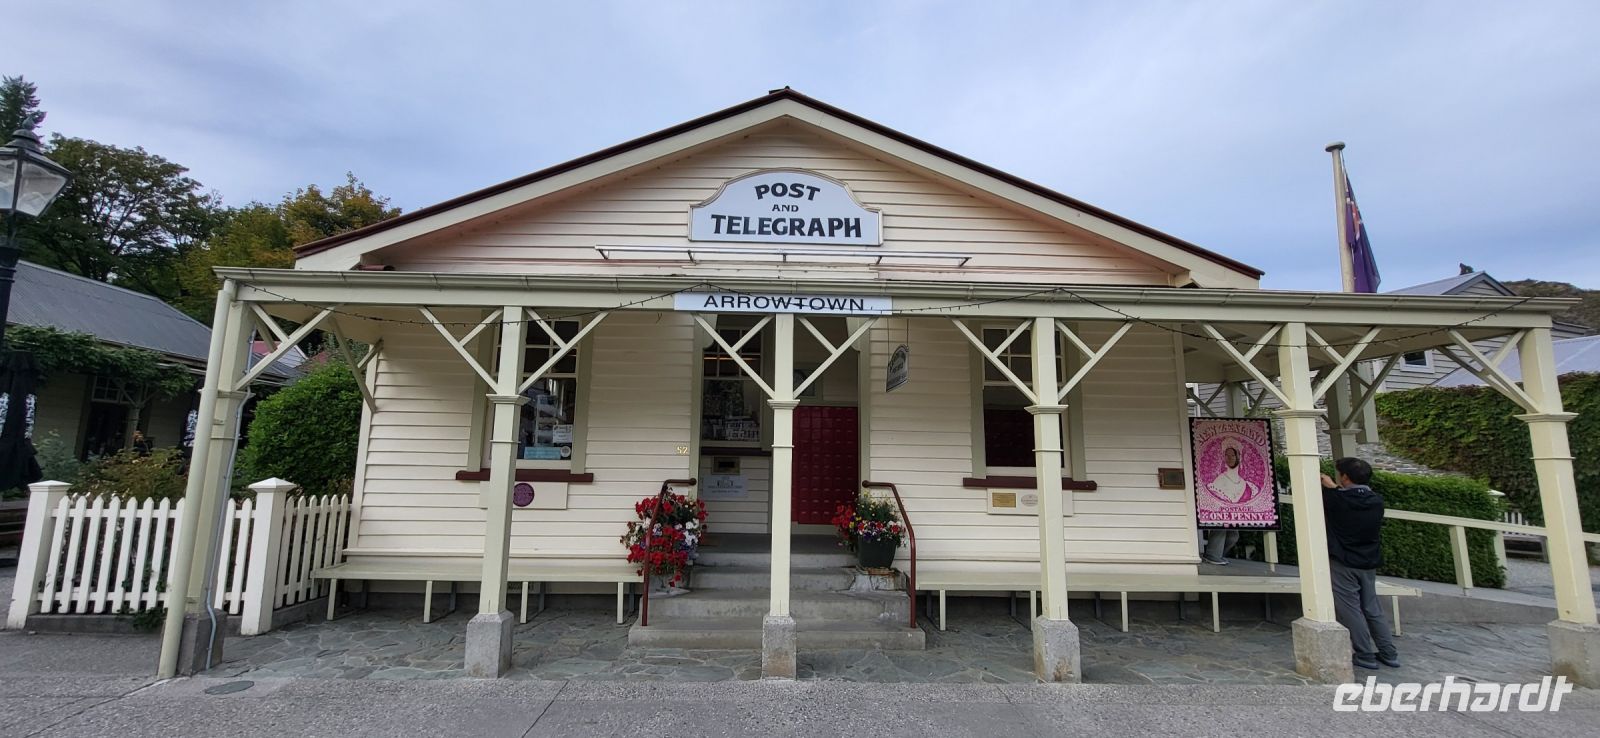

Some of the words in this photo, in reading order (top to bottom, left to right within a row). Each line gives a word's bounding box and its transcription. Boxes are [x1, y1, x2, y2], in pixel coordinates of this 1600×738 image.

[755, 182, 820, 201] POST
[771, 204, 799, 212] AND
[711, 214, 862, 238] TELEGRAPH
[703, 295, 864, 311] ARROWTOWN
[1219, 423, 1266, 446] ZEALAND
[1210, 512, 1230, 520] ONE
[1231, 512, 1264, 521] PENNY
